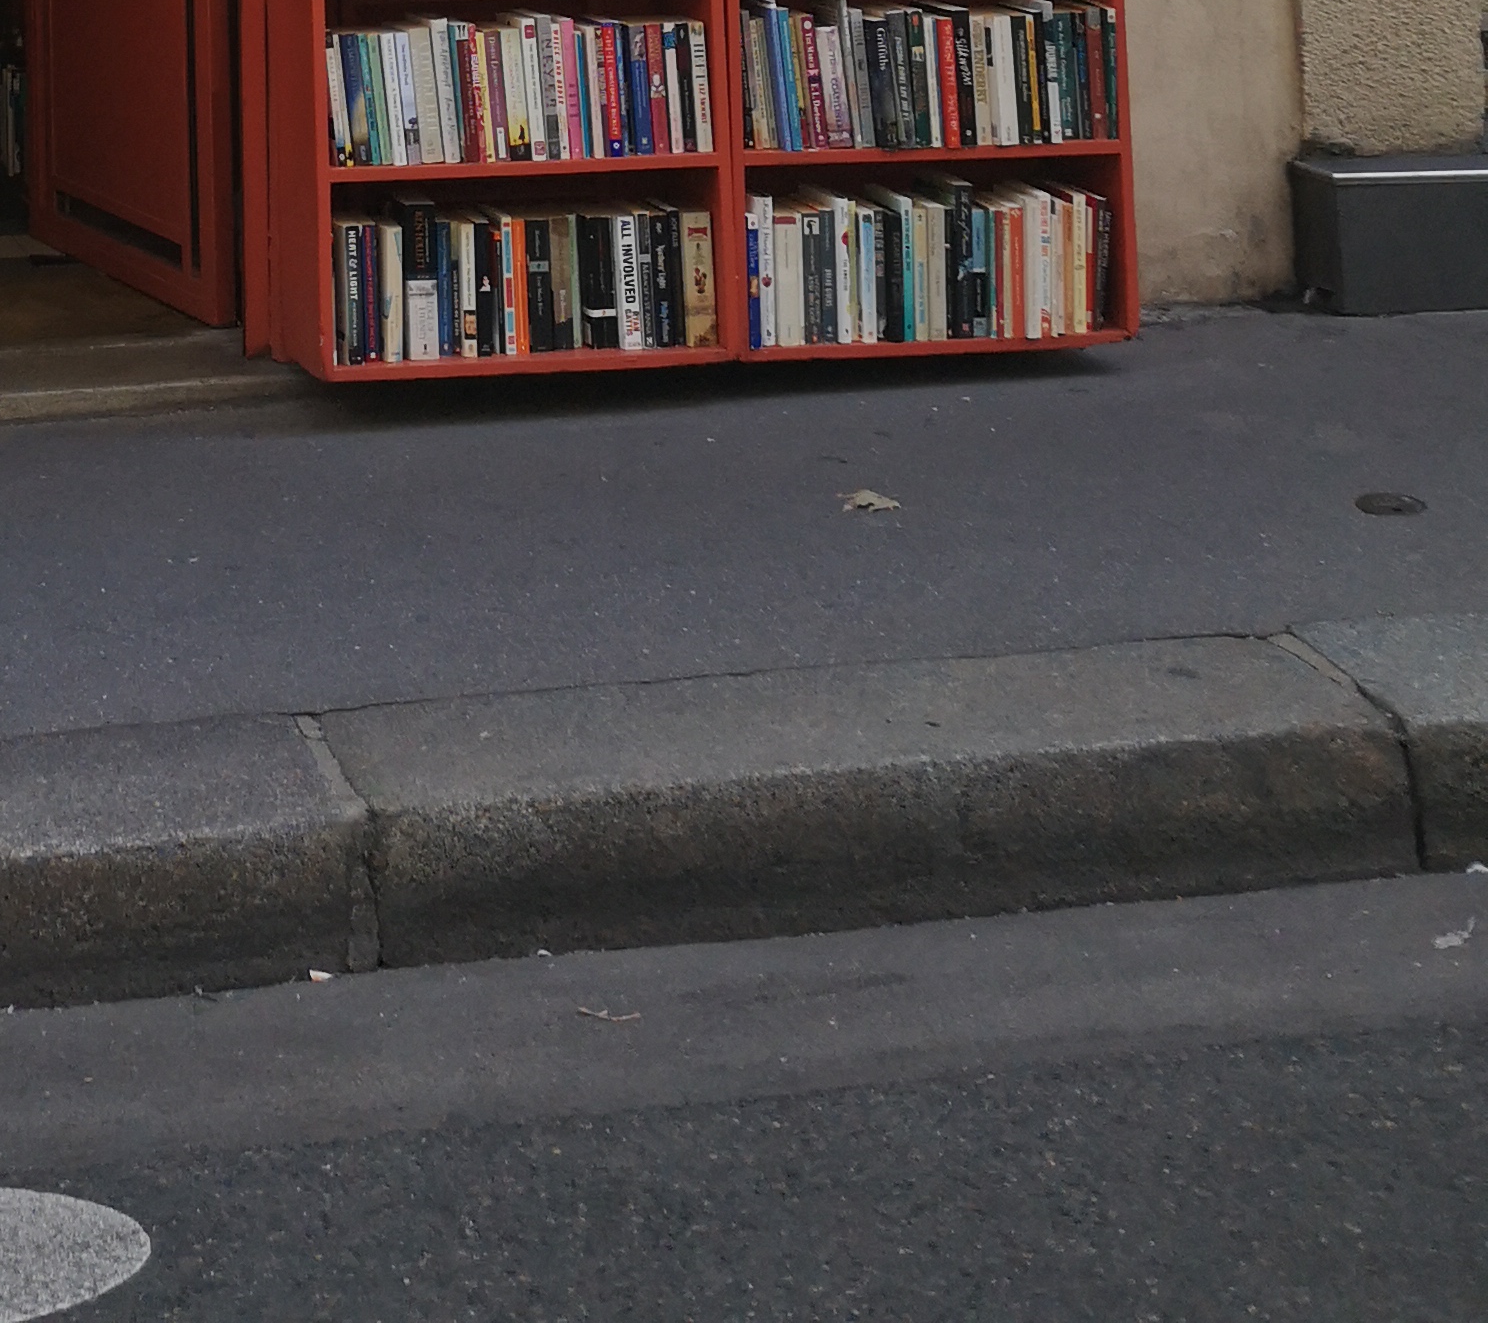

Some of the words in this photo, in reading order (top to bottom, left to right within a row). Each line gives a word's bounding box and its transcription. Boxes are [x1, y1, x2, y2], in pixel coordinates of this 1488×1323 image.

[876, 28, 888, 71] Griffiths
[955, 38, 971, 86] Silkworm
[974, 50, 987, 104] ENDERBY
[348, 231, 357, 256] HEAT
[620, 220, 631, 239] ALL
[349, 271, 358, 300] LIGHT
[621, 244, 636, 304] INVOLVED
[625, 309, 633, 337] GATTIS
[632, 311, 640, 332] RYAN
